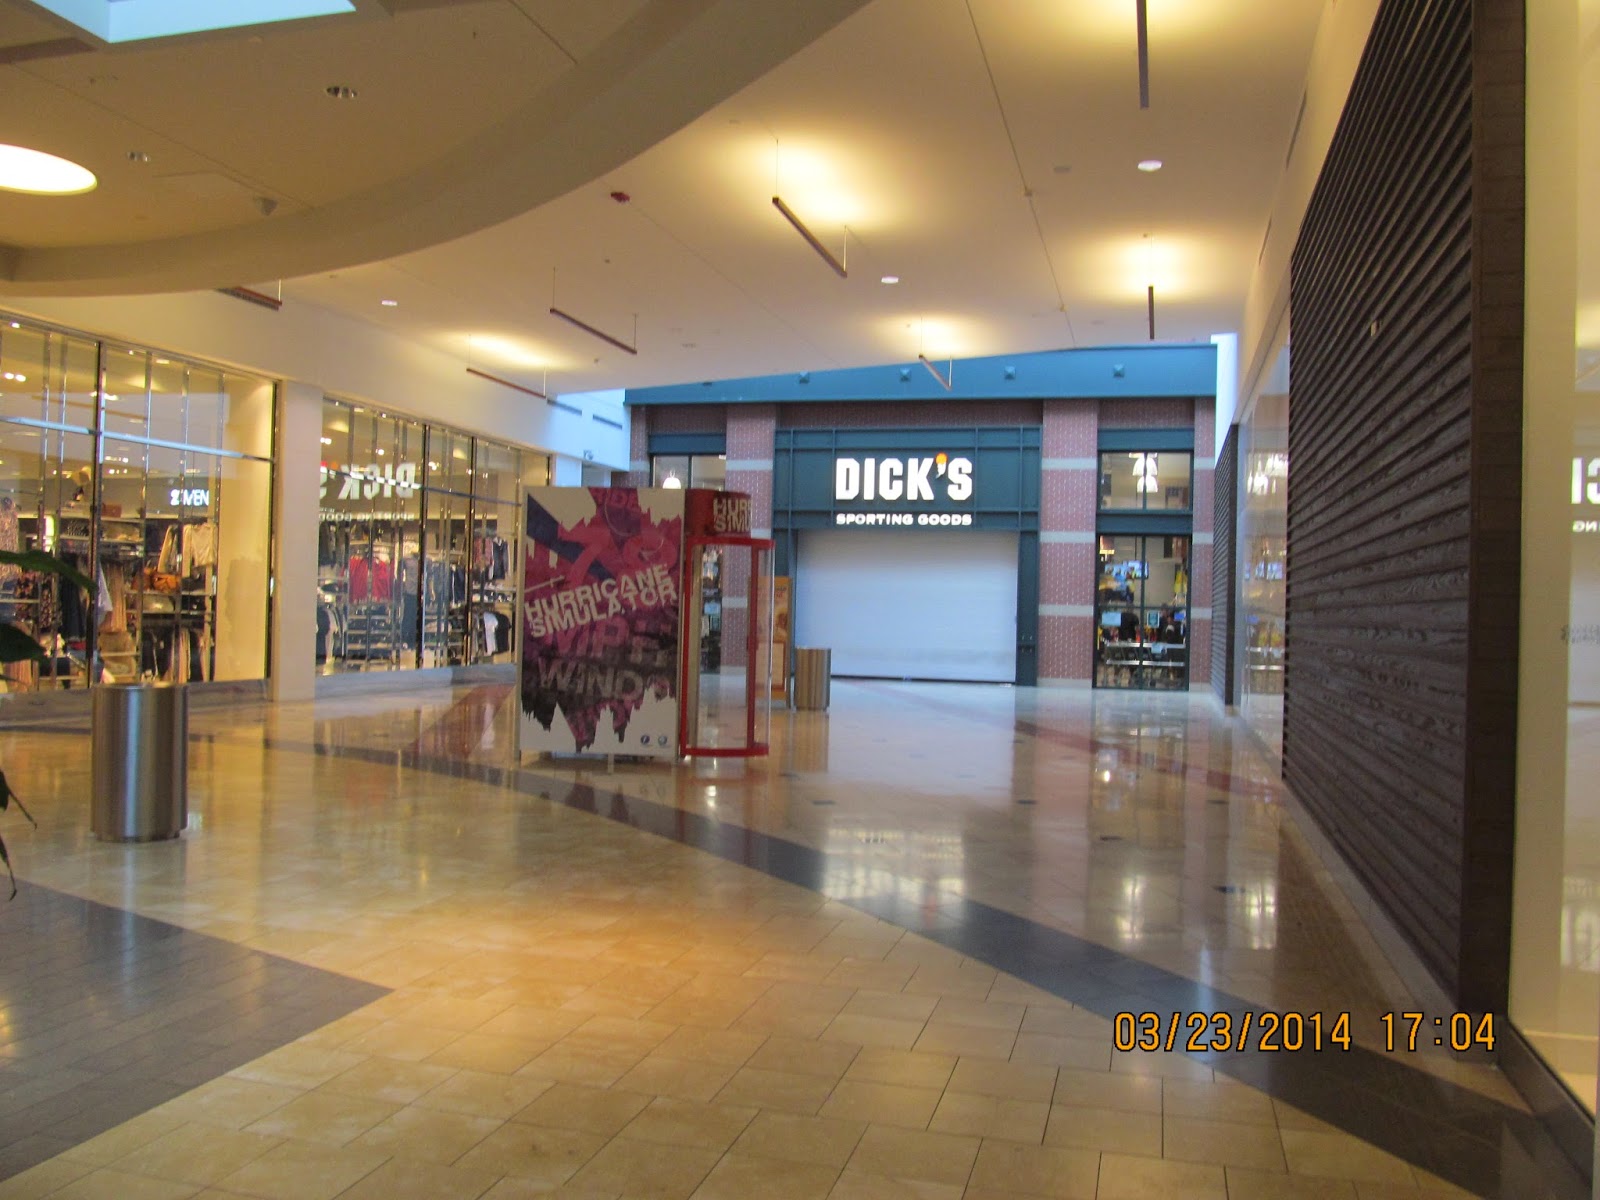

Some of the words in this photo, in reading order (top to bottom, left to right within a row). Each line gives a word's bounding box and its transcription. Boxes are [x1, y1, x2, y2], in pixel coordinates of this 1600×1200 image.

[835, 452, 973, 501] DICK'S
[836, 513, 914, 526] SPORTING
[917, 513, 973, 526] GOODS
[524, 563, 670, 627] HURRICANE
[530, 575, 678, 638] SIMULATOR
